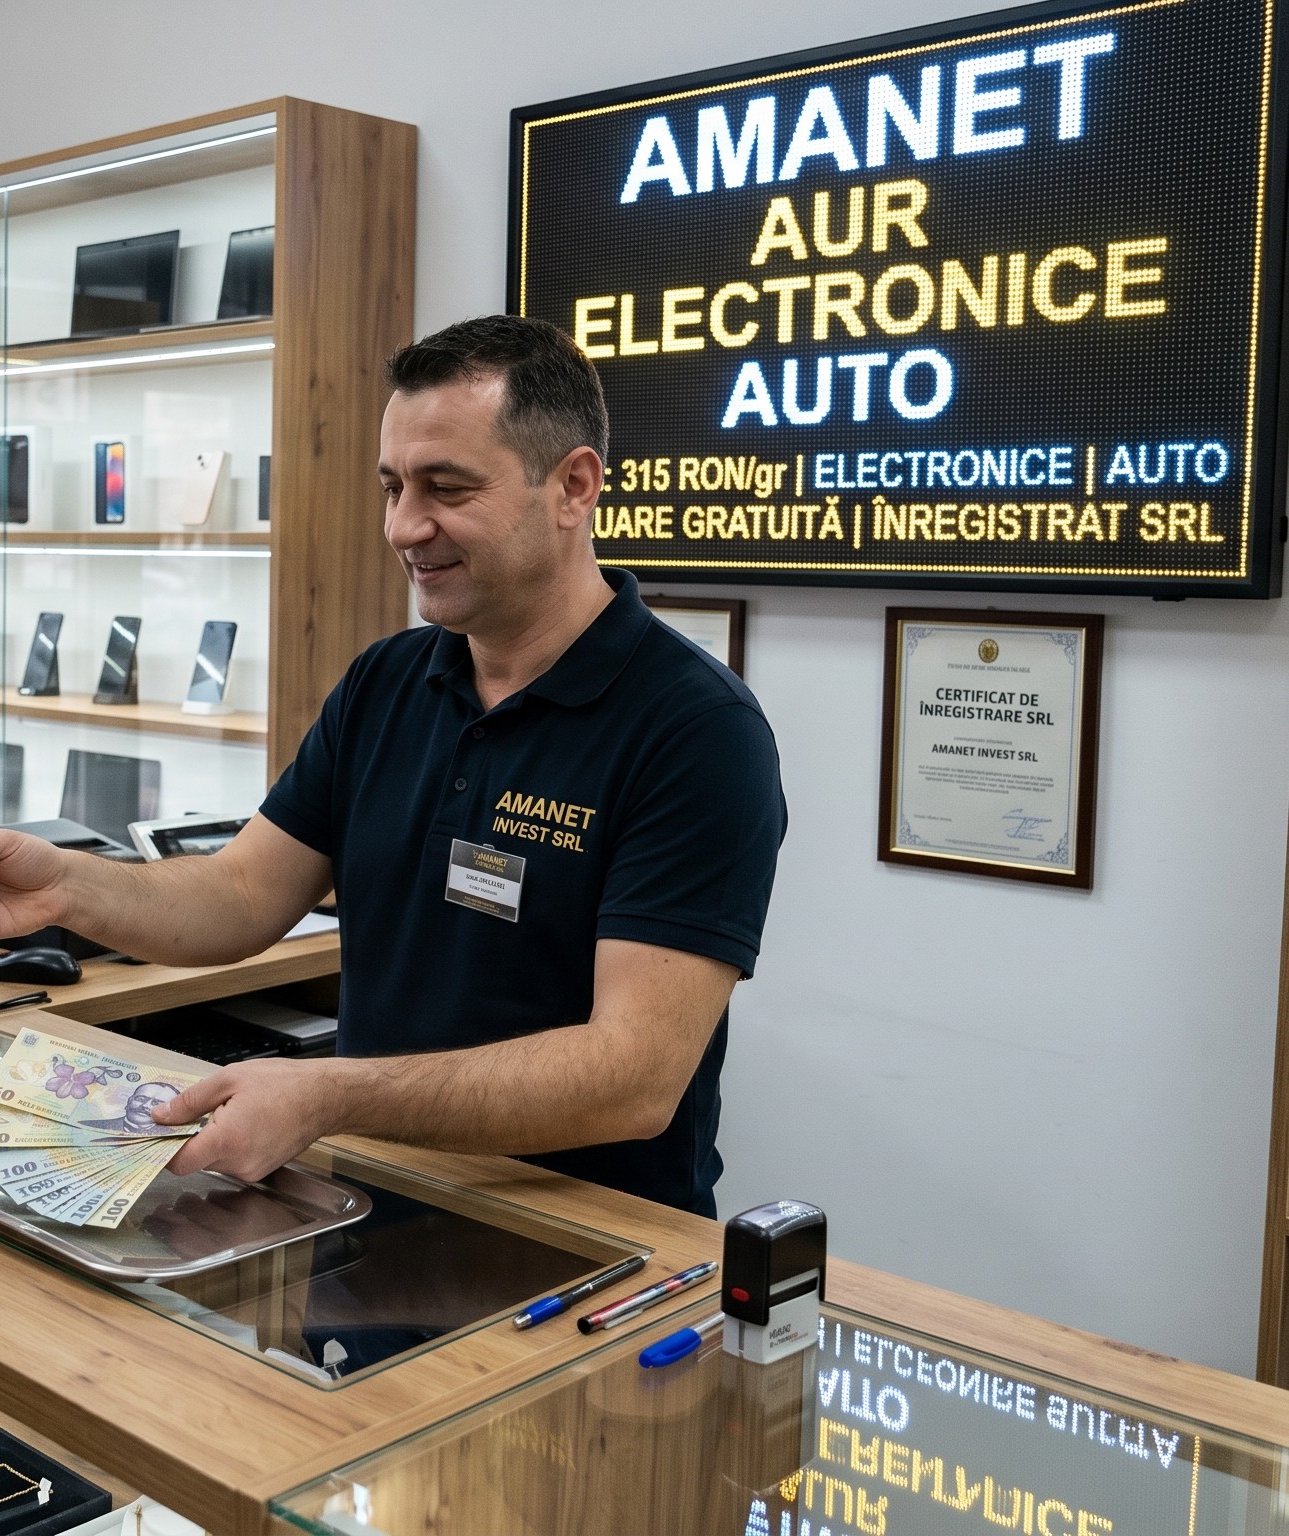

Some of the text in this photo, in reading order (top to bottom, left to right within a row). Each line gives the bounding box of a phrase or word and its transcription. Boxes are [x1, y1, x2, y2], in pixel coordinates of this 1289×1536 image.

[619, 32, 1115, 204] AMANET
[750, 178, 929, 266] AUR
[574, 237, 1168, 360] ELECTRONICE
[720, 348, 954, 429] AUTO
[621, 457, 671, 492] 315
[678, 455, 788, 499] RON/gr
[814, 447, 1073, 489] ELECTRONICE
[1105, 443, 1229, 484] AUTO
[590, 505, 674, 540] UARE
[681, 495, 845, 541] GRATUITĂ
[871, 494, 1128, 542] ÎNREGISTRAT
[1139, 502, 1225, 543] SRL
[919, 700, 1055, 726] ÎNREGISTRARE SRL
[935, 687, 1039, 707] CERTIFICAT DE
[931, 743, 1039, 763] AMANET INVEST SRL
[495, 790, 597, 830] AMANET
[492, 815, 584, 853] INVEST SRL
[0, 1161, 38, 1180] 100
[100, 1197, 130, 1225] 100
